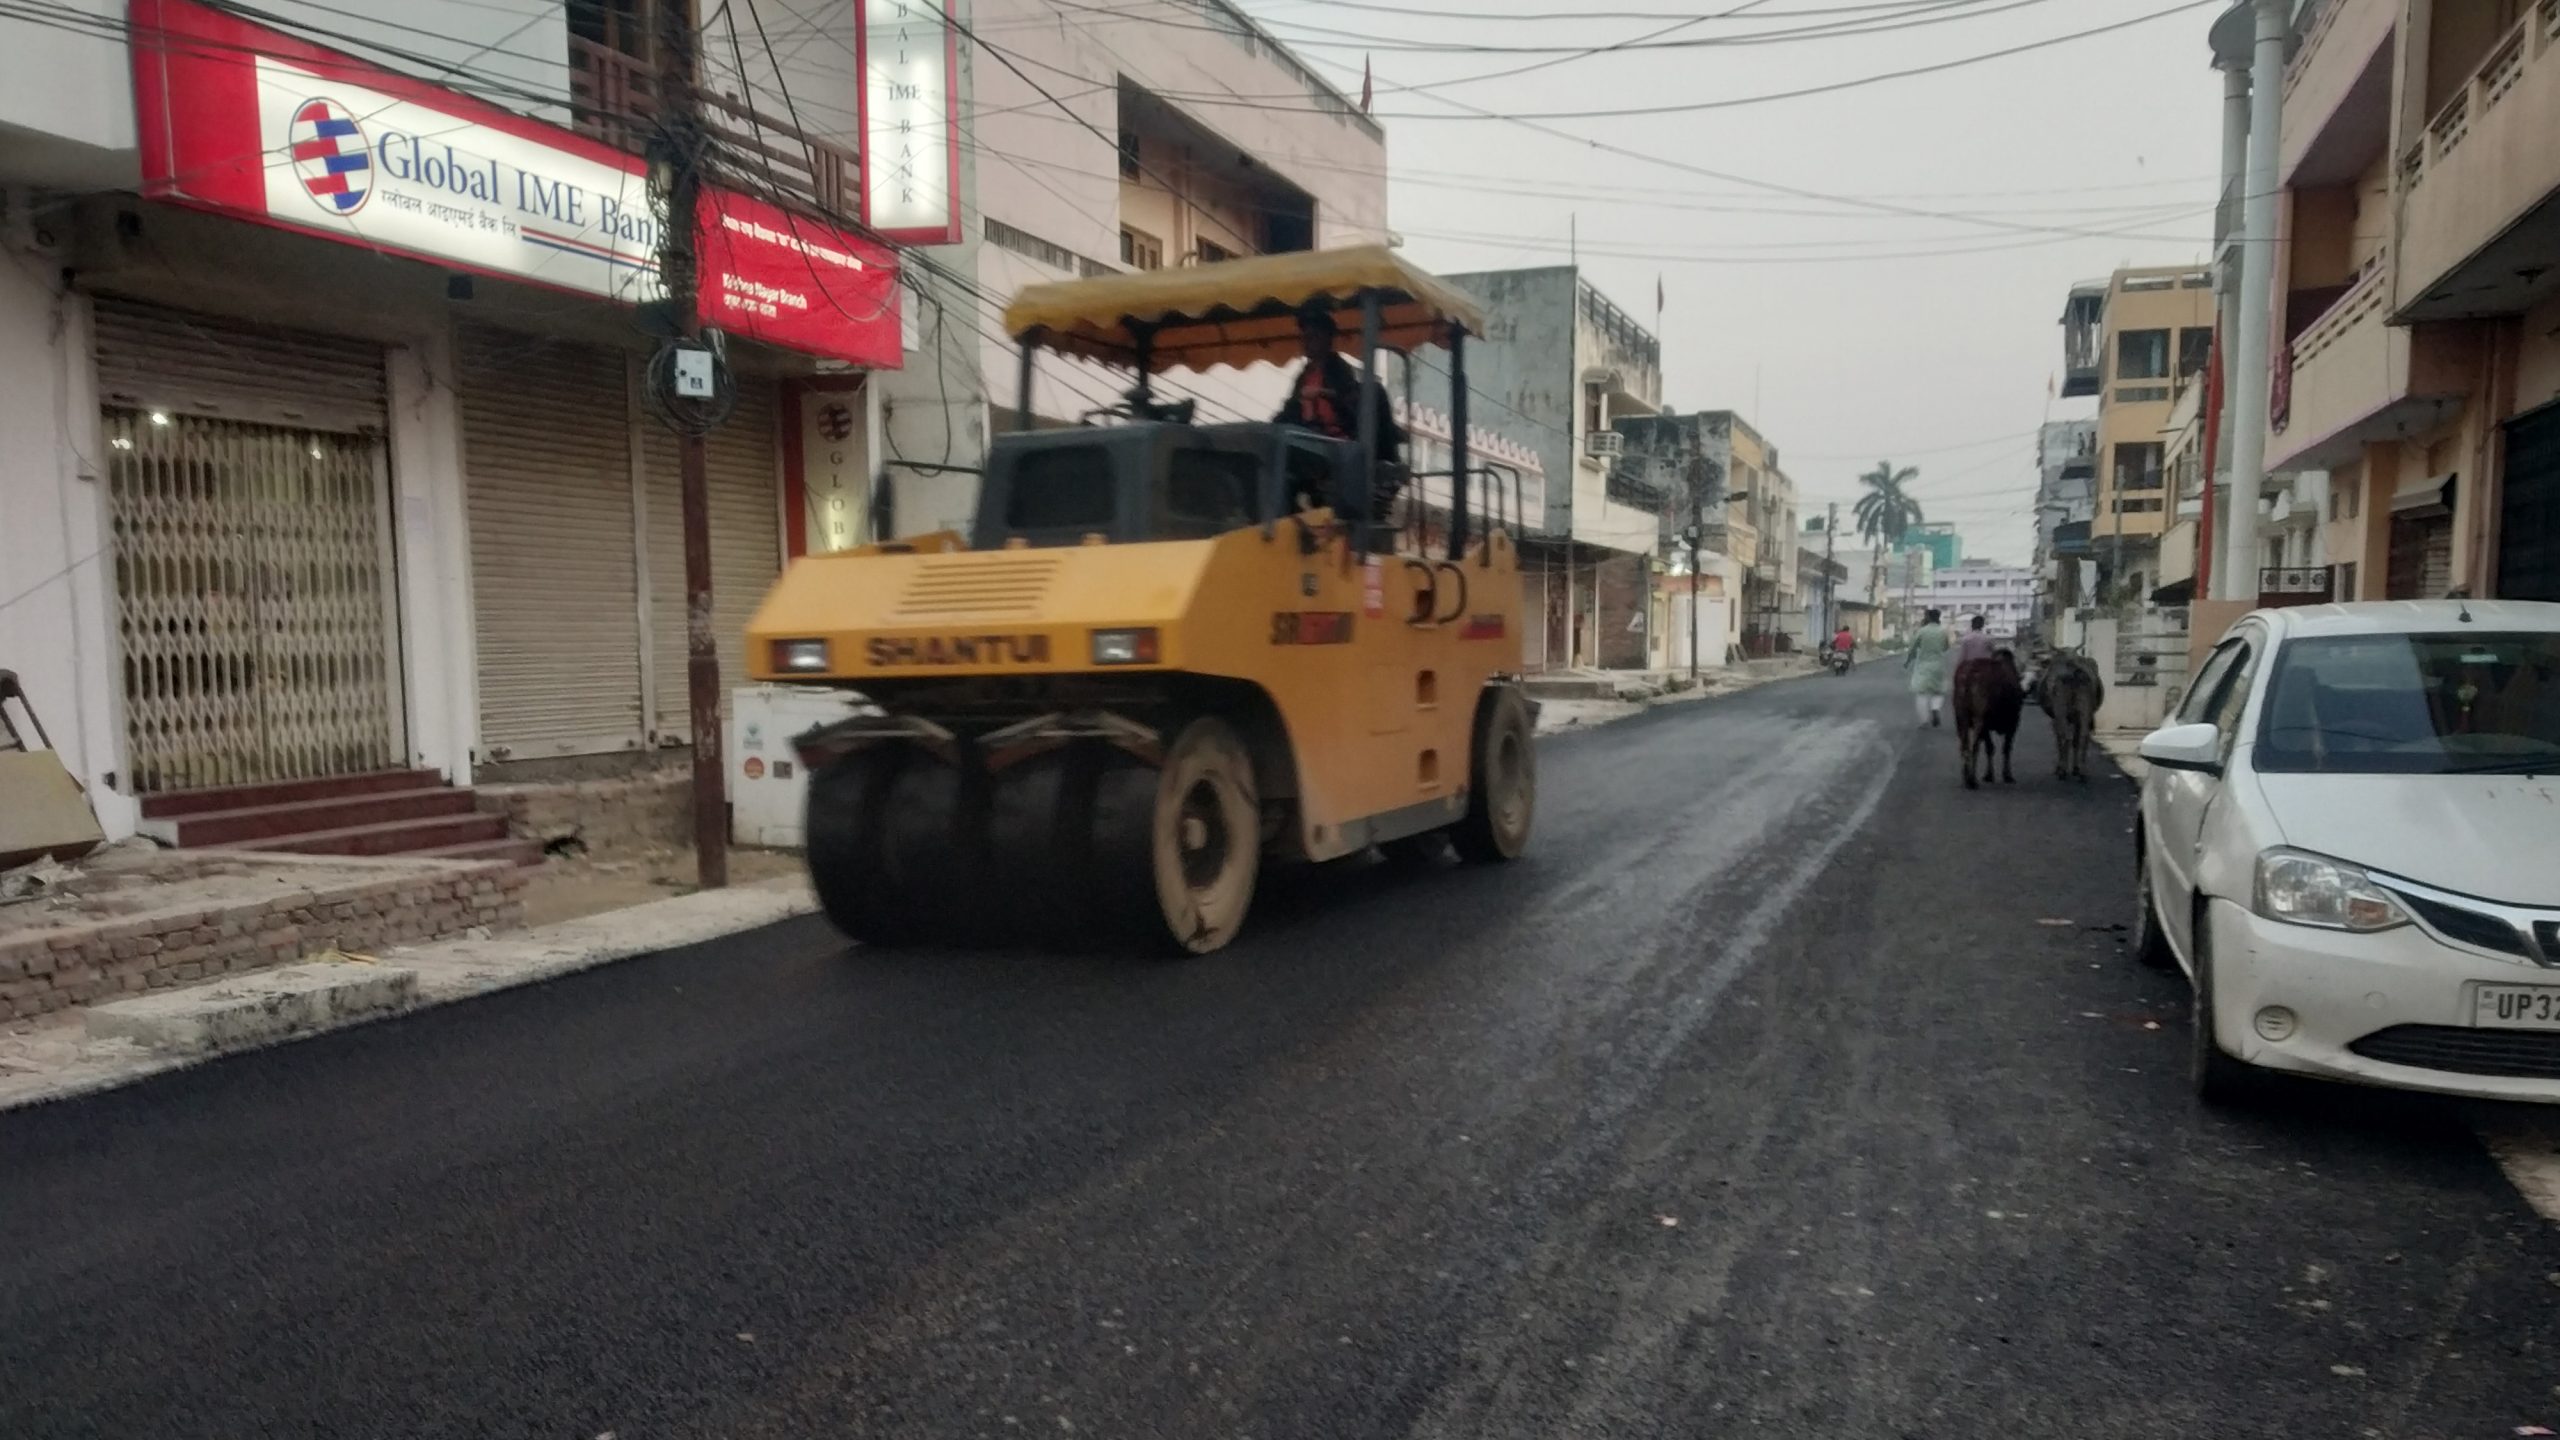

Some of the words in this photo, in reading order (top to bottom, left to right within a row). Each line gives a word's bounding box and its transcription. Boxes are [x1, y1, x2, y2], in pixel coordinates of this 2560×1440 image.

[889, 85, 921, 101] IME
[378, 131, 502, 205] Global
[513, 168, 587, 228] IME
[598, 193, 671, 250] Ban
[900, 118, 914, 204] BANK
[829, 451, 845, 550] GLOB
[866, 633, 1050, 668] SHANTUI
